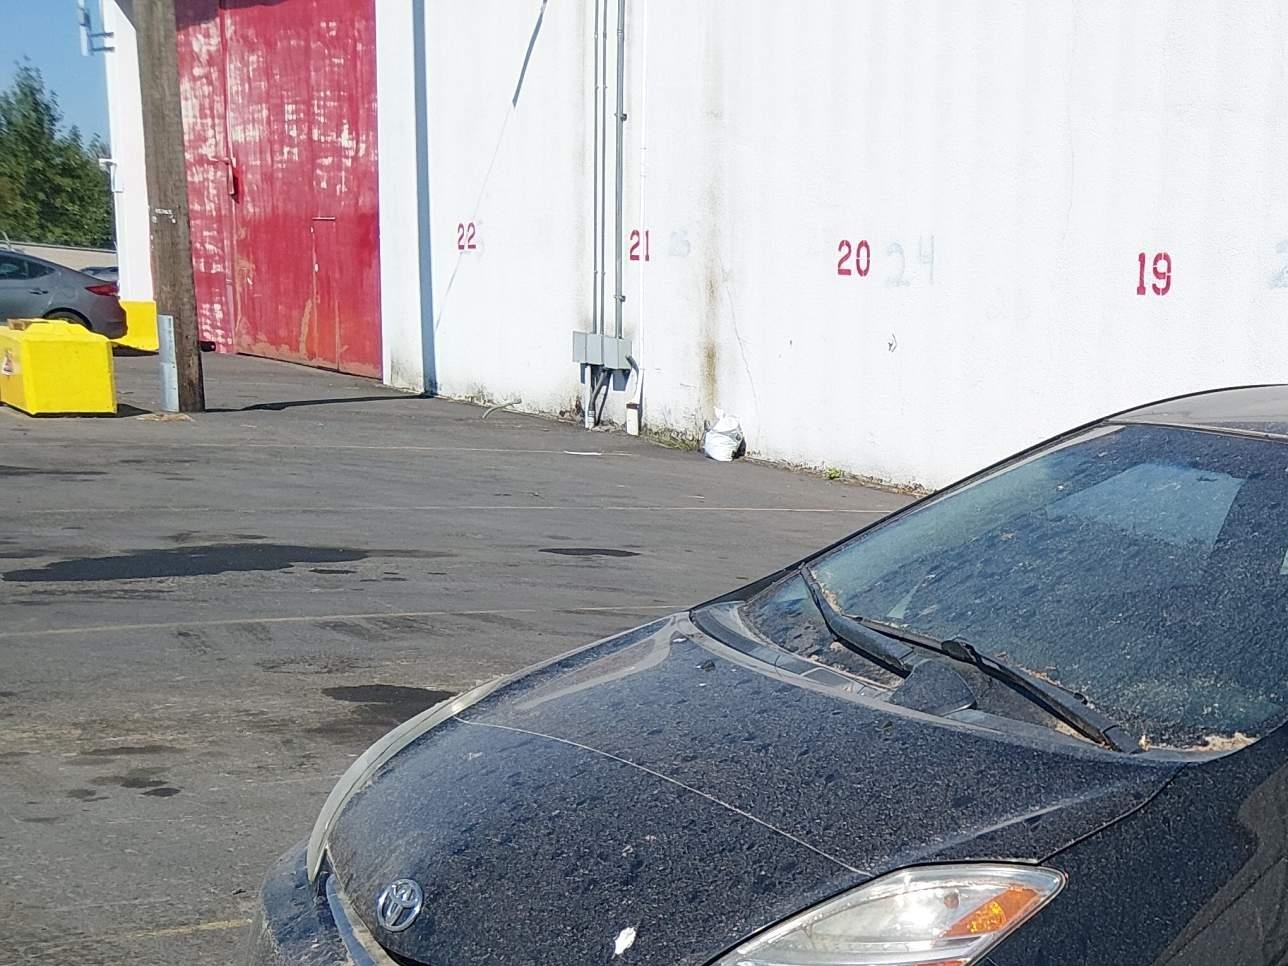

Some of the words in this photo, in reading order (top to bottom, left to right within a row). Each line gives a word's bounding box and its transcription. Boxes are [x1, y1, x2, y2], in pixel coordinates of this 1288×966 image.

[457, 222, 477, 250] 22
[629, 229, 651, 262] 21
[837, 239, 871, 277] 20
[1136, 252, 1173, 297] 19
